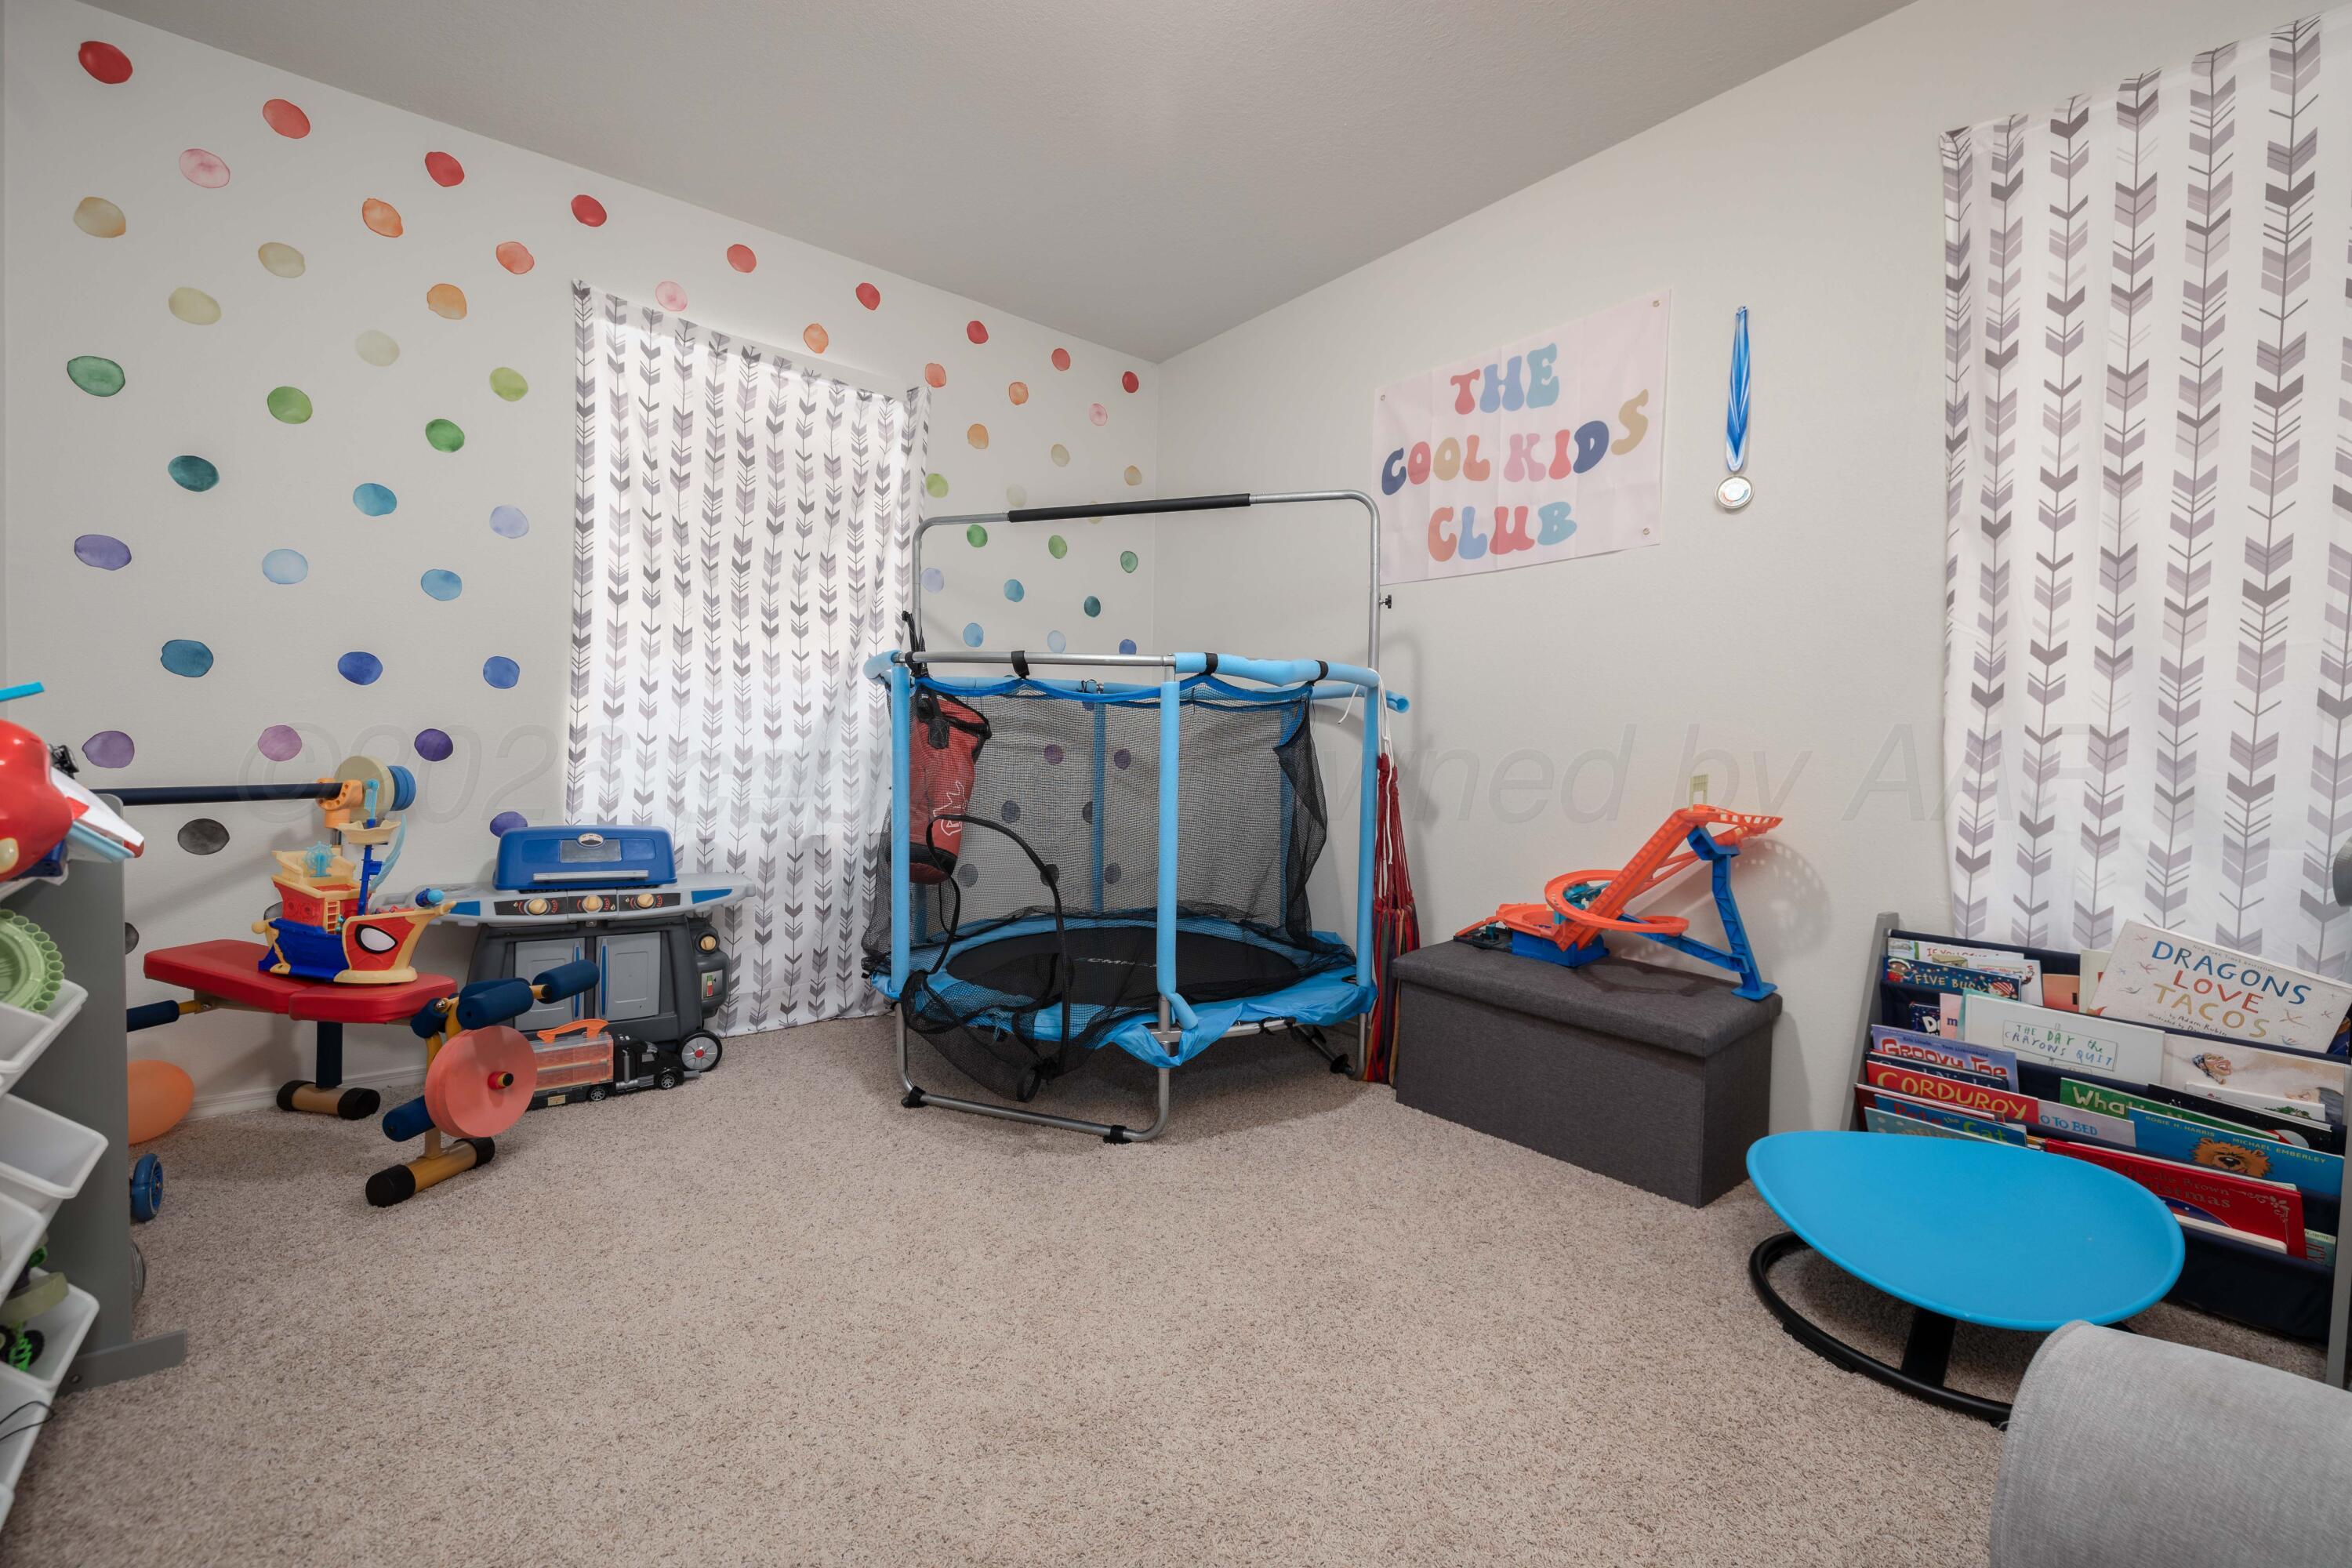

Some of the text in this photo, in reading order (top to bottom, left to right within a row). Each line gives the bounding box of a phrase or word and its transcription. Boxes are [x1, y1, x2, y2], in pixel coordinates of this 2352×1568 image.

[1450, 342, 1559, 416] THE
[1381, 388, 1650, 495] COOL KIDS
[1427, 500, 1577, 563] CLUB
[1915, 975, 1946, 985] FIVE
[2151, 940, 2311, 1005] DRAGONS
[2172, 970, 2263, 1014] LOVE
[2154, 982, 2270, 1038] TACOS
[2005, 1031, 2067, 1056] CRAYONS
[2076, 1049, 2114, 1066] QUIT
[2016, 1024, 2103, 1053] THE DAY the
[1877, 1072, 2027, 1120] CORDUROY
[2053, 1116, 2069, 1130] TO
[2072, 1121, 2098, 1137] BED
[2145, 1116, 2170, 1127] ROBIE
[2184, 1127, 2216, 1137] HARRIS
[2232, 1137, 2327, 1164] MICHAEL EMBERLEY
